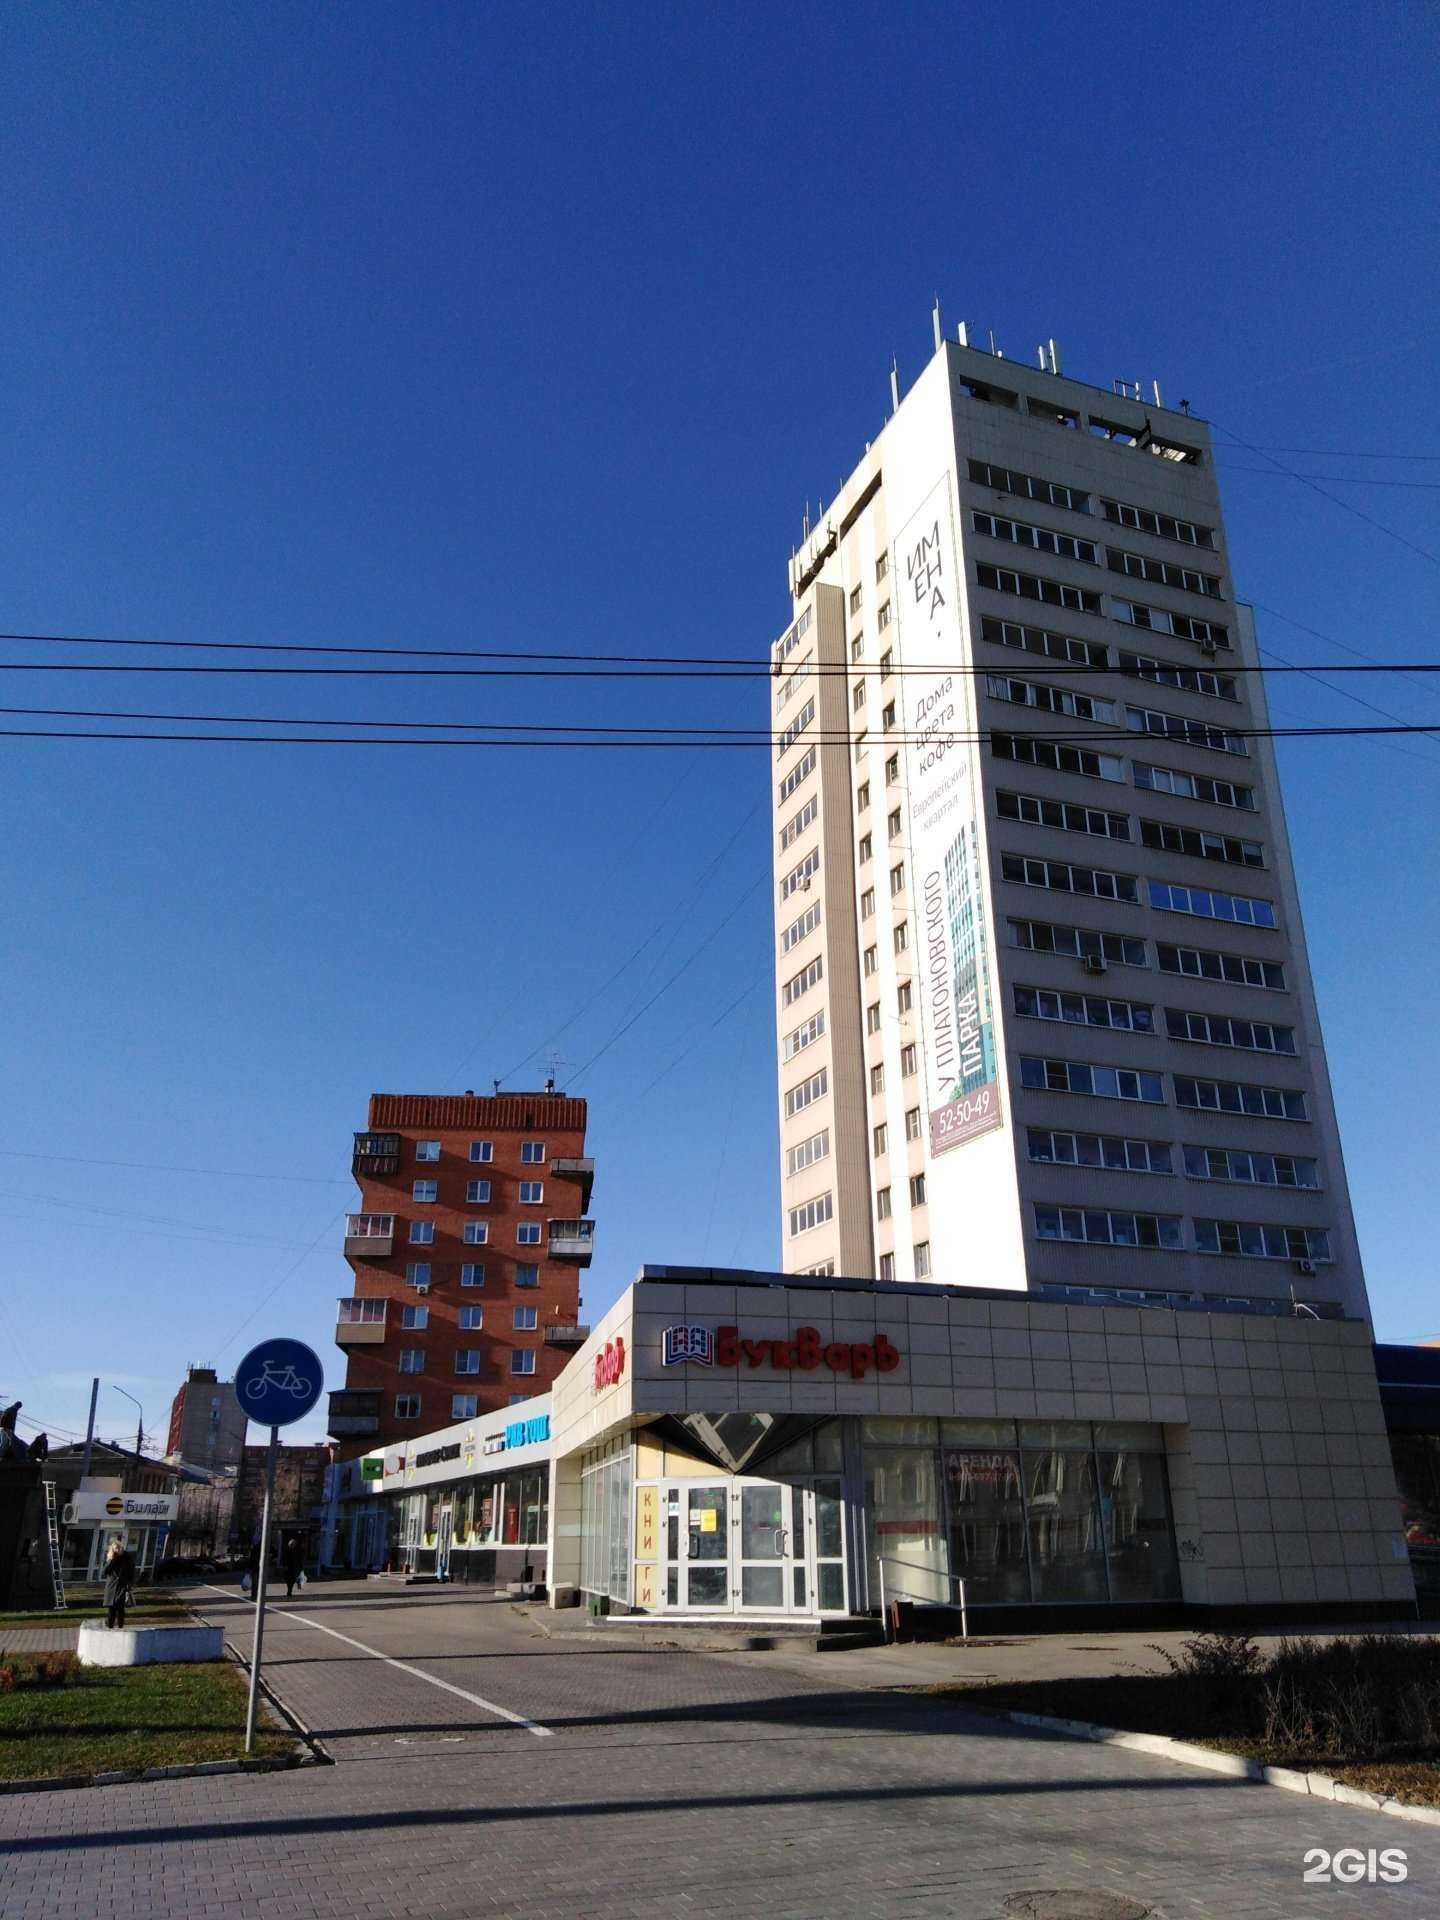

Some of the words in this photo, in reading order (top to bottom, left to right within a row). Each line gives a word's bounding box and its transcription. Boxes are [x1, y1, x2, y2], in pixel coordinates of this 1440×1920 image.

[907, 519, 940, 580] ИМ
[914, 549, 942, 603] ЕН
[915, 676, 953, 728] Дома
[916, 703, 954, 750] цвета
[919, 731, 954, 776] кофе
[912, 760, 967, 819] Европейский
[923, 793, 959, 832] квартал
[923, 870, 954, 1069] ПЛАТОНОВСКОГО
[957, 990, 982, 1078] ПАРКА
[939, 1076, 955, 1092] У
[939, 1090, 990, 1135] 52-50-49
[949, 1454, 1013, 1470] АРЕНДА
[643, 1493, 652, 1602] КНИГИ
